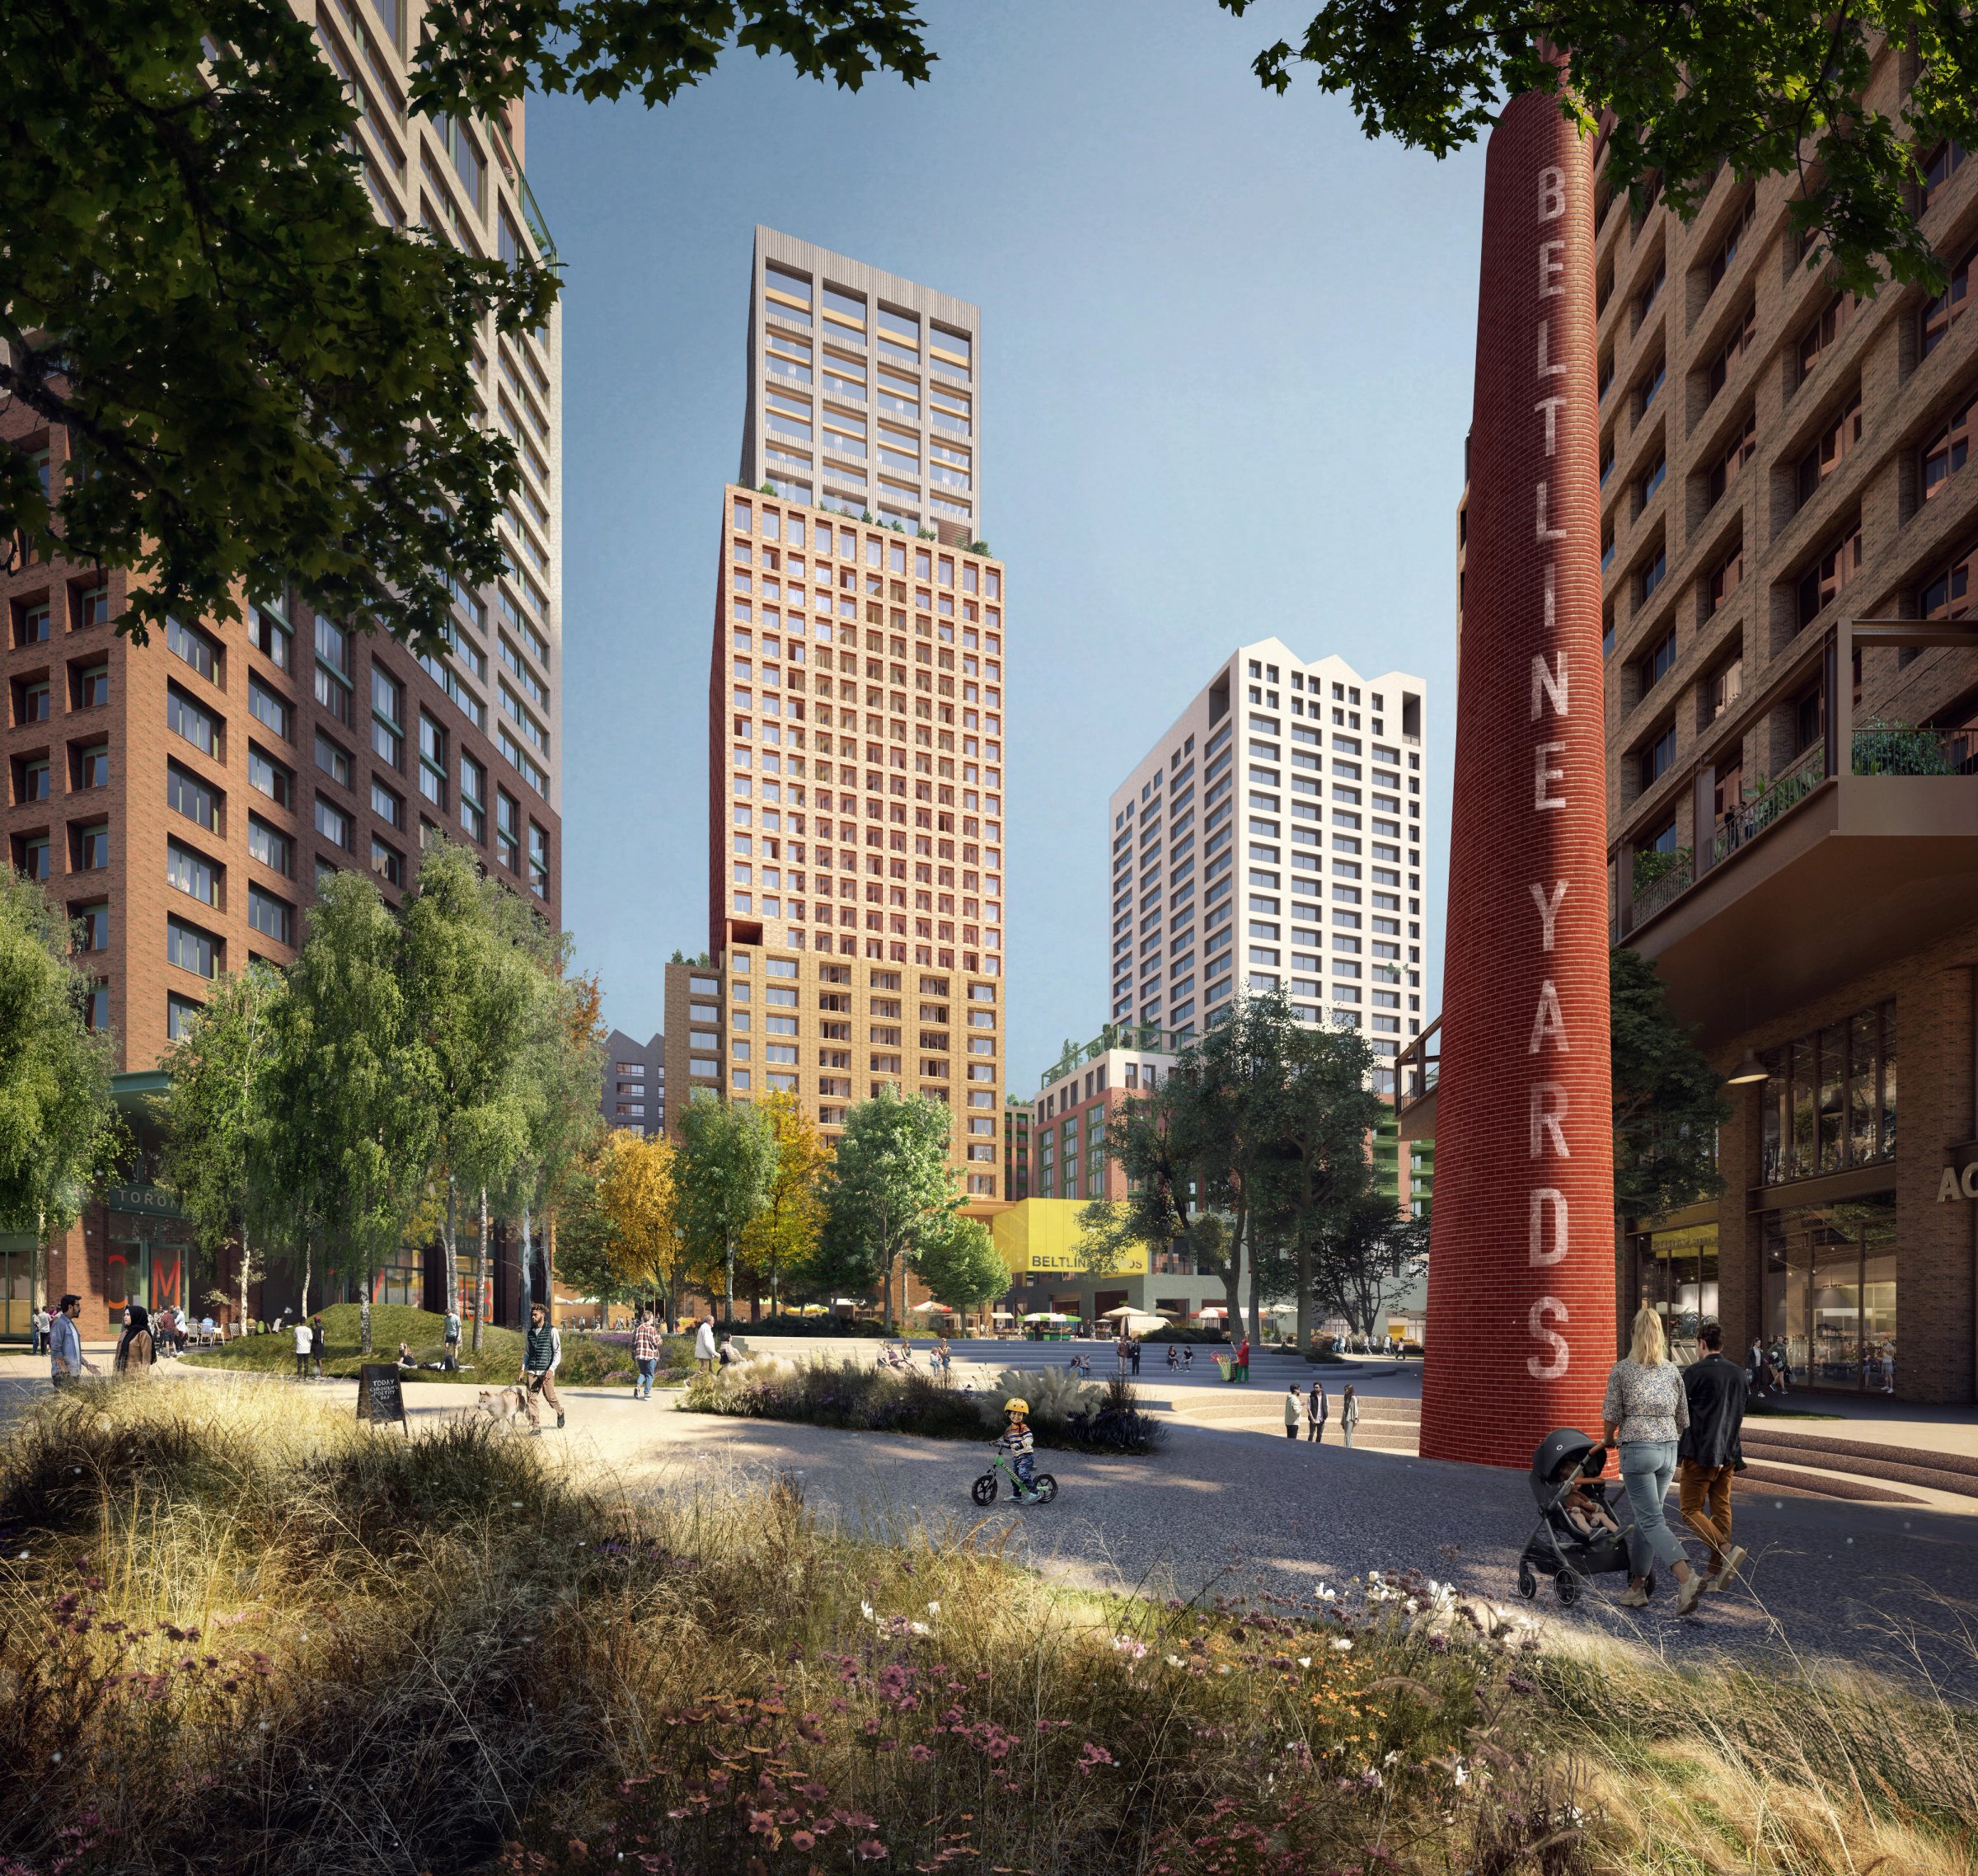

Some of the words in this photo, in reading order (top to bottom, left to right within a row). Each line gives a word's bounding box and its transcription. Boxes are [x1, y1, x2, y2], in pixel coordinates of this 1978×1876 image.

[1530, 165, 1568, 810] BELTLINE
[1033, 1255, 1088, 1268] BELTLIN
[1528, 880, 1570, 1381] YARDS
